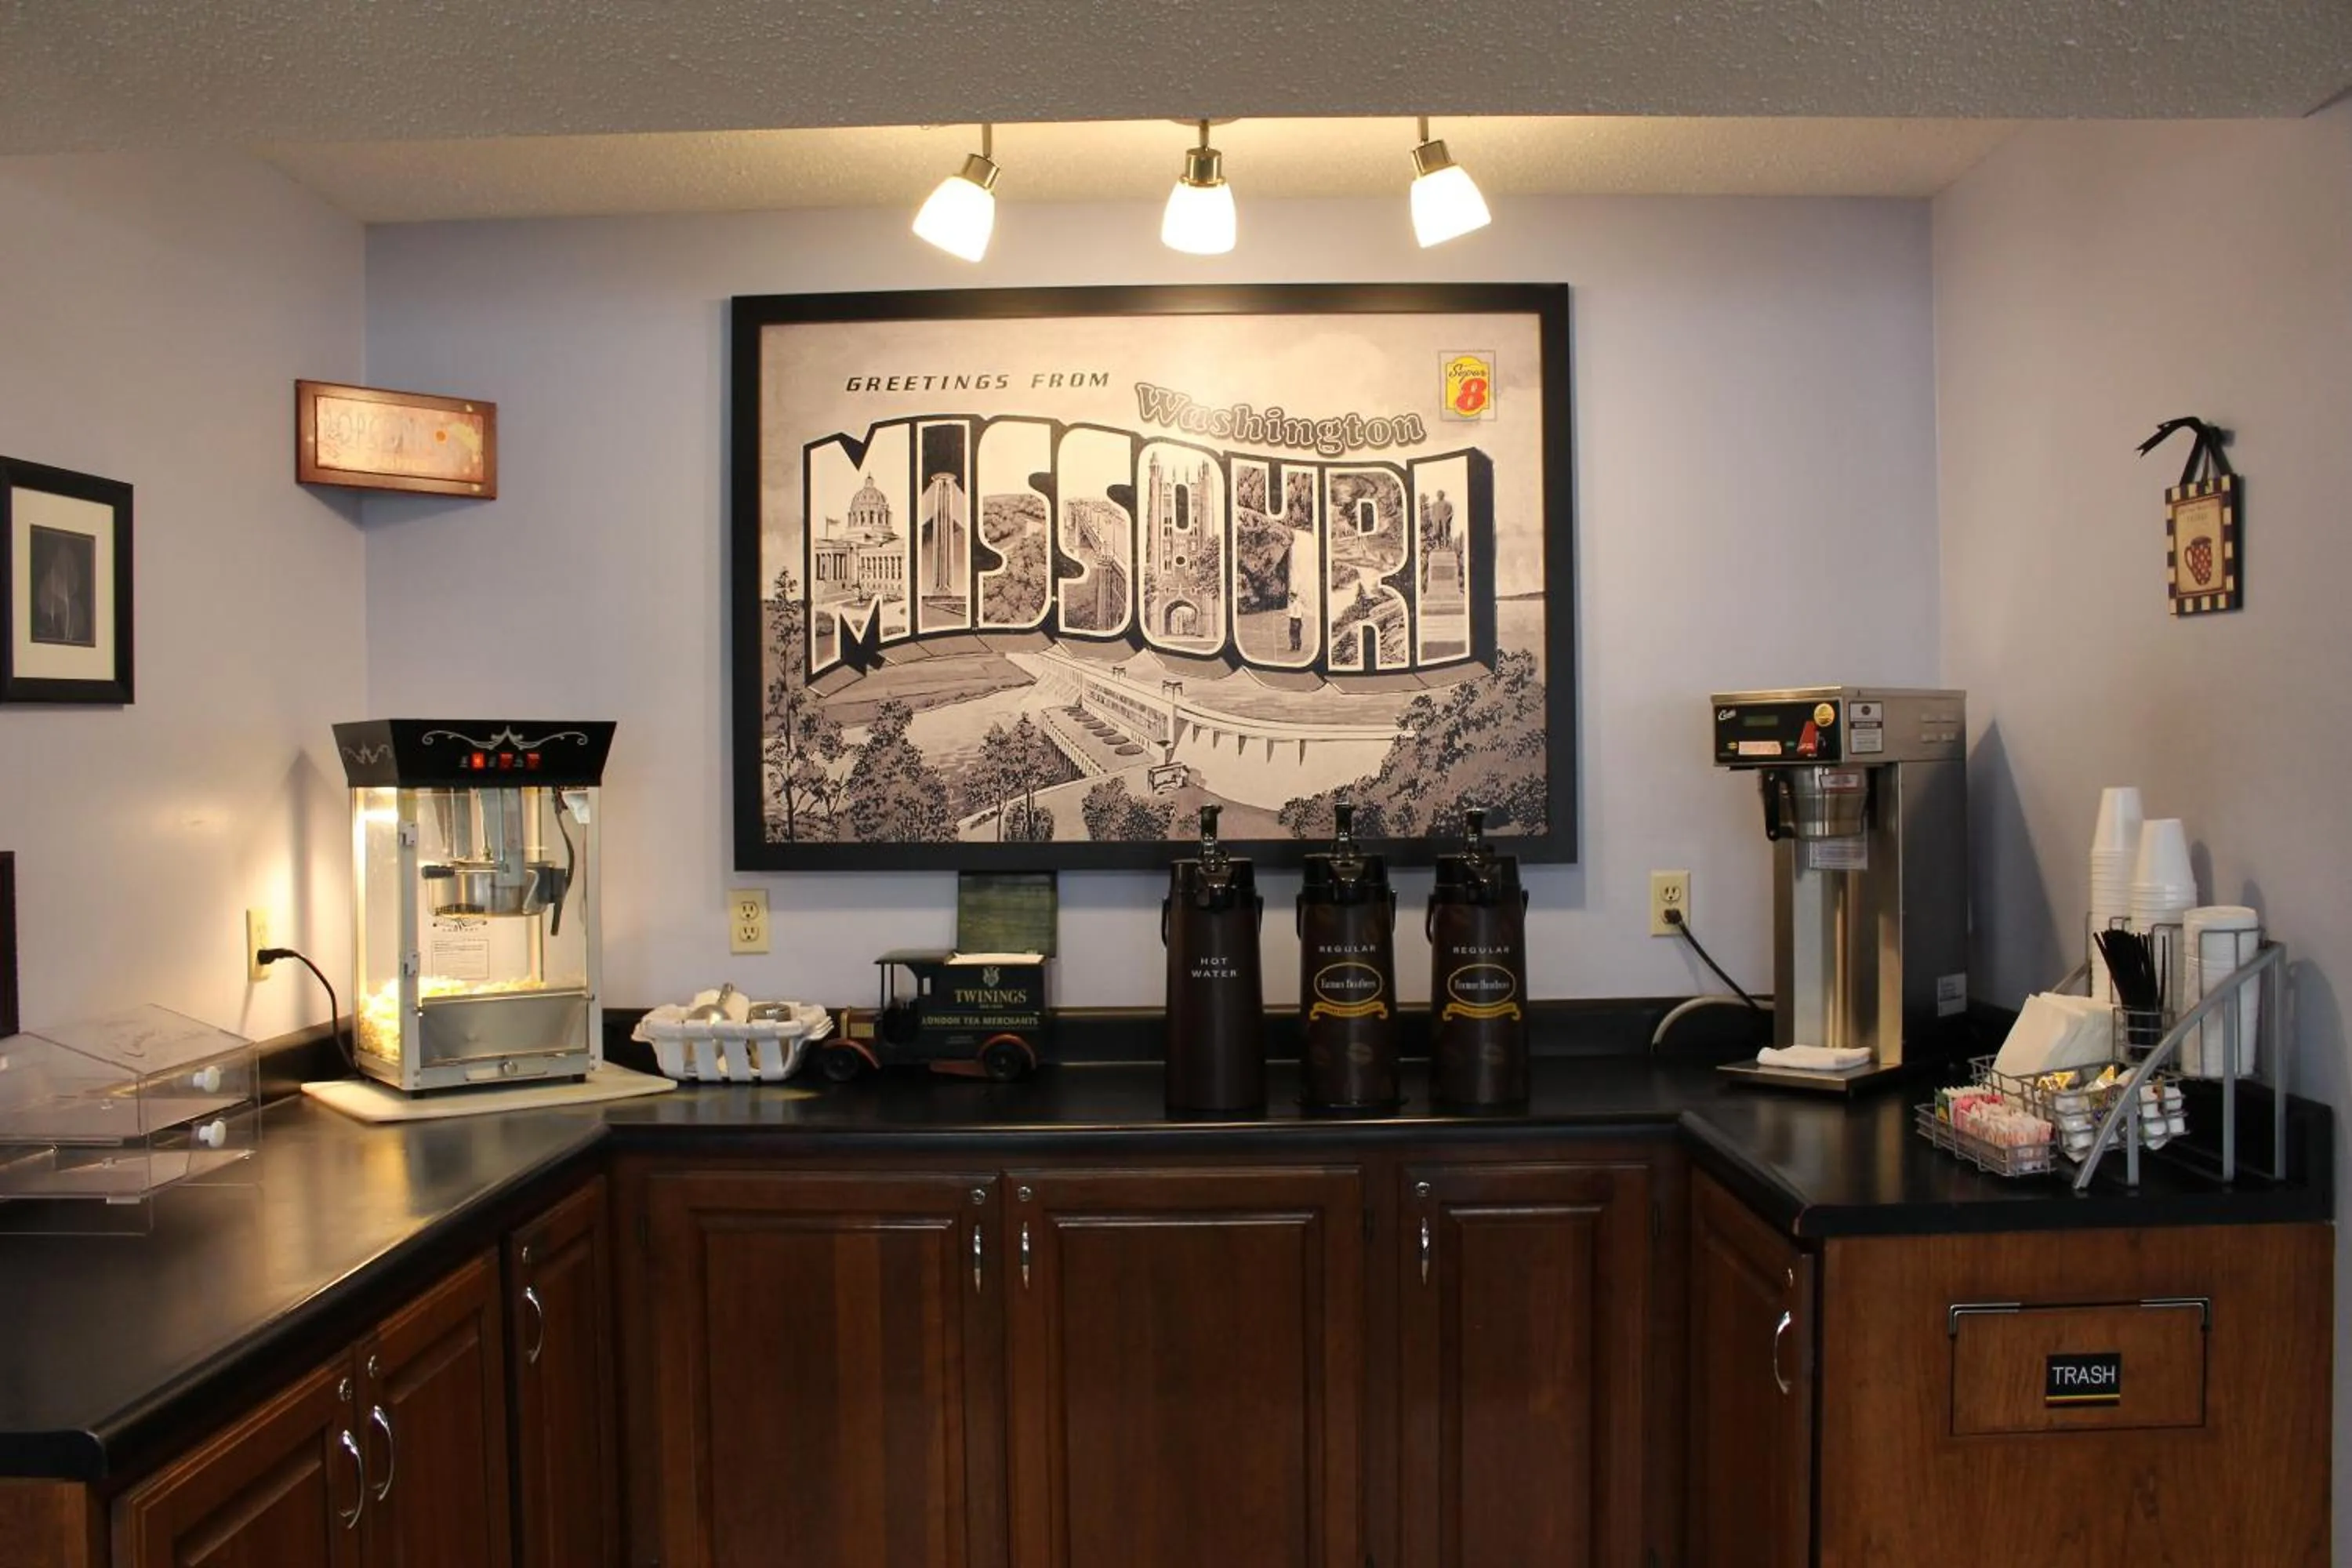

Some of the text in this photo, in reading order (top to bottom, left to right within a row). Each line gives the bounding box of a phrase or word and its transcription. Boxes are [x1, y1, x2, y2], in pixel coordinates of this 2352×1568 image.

[1448, 363, 1487, 383] Super
[846, 372, 1109, 392] GREETINGS FROM
[1454, 377, 1487, 412] 8
[1135, 383, 1425, 456] Washington
[804, 414, 1496, 684] MISSOURI
[1319, 945, 1376, 953] REGULAR
[1453, 946, 1510, 954] REGULAR
[1200, 956, 1228, 966] HOT
[1191, 969, 1237, 978] WATER
[954, 989, 1026, 1004] TWININGS
[922, 1015, 1039, 1025] LONDON TEA MERCHANTS
[2052, 1365, 2116, 1385] TRASH
